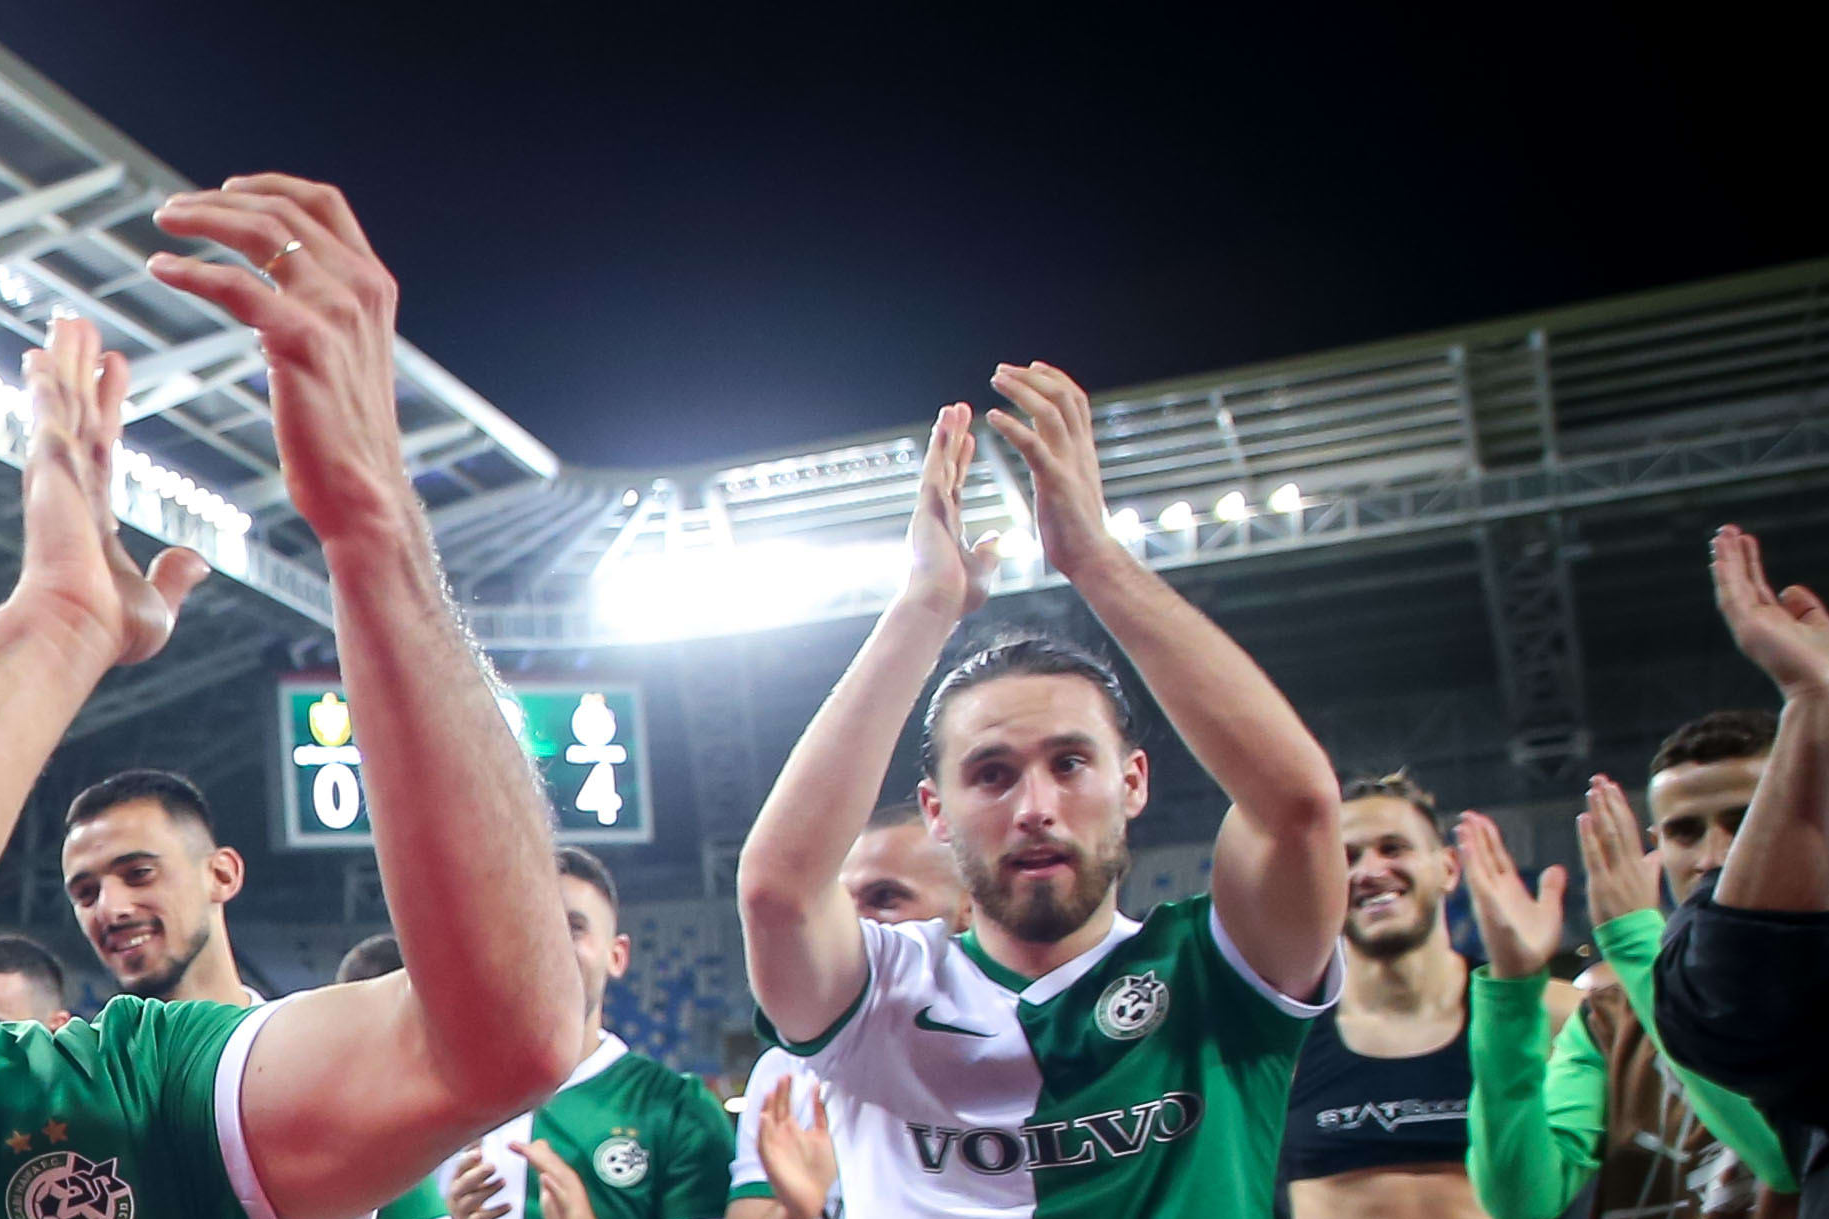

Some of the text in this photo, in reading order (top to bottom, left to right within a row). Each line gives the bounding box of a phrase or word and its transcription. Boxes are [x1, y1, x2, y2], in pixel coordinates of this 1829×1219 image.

[313, 763, 360, 829] 0
[575, 762, 623, 825] 4
[906, 1091, 1206, 1175] VOLVO
